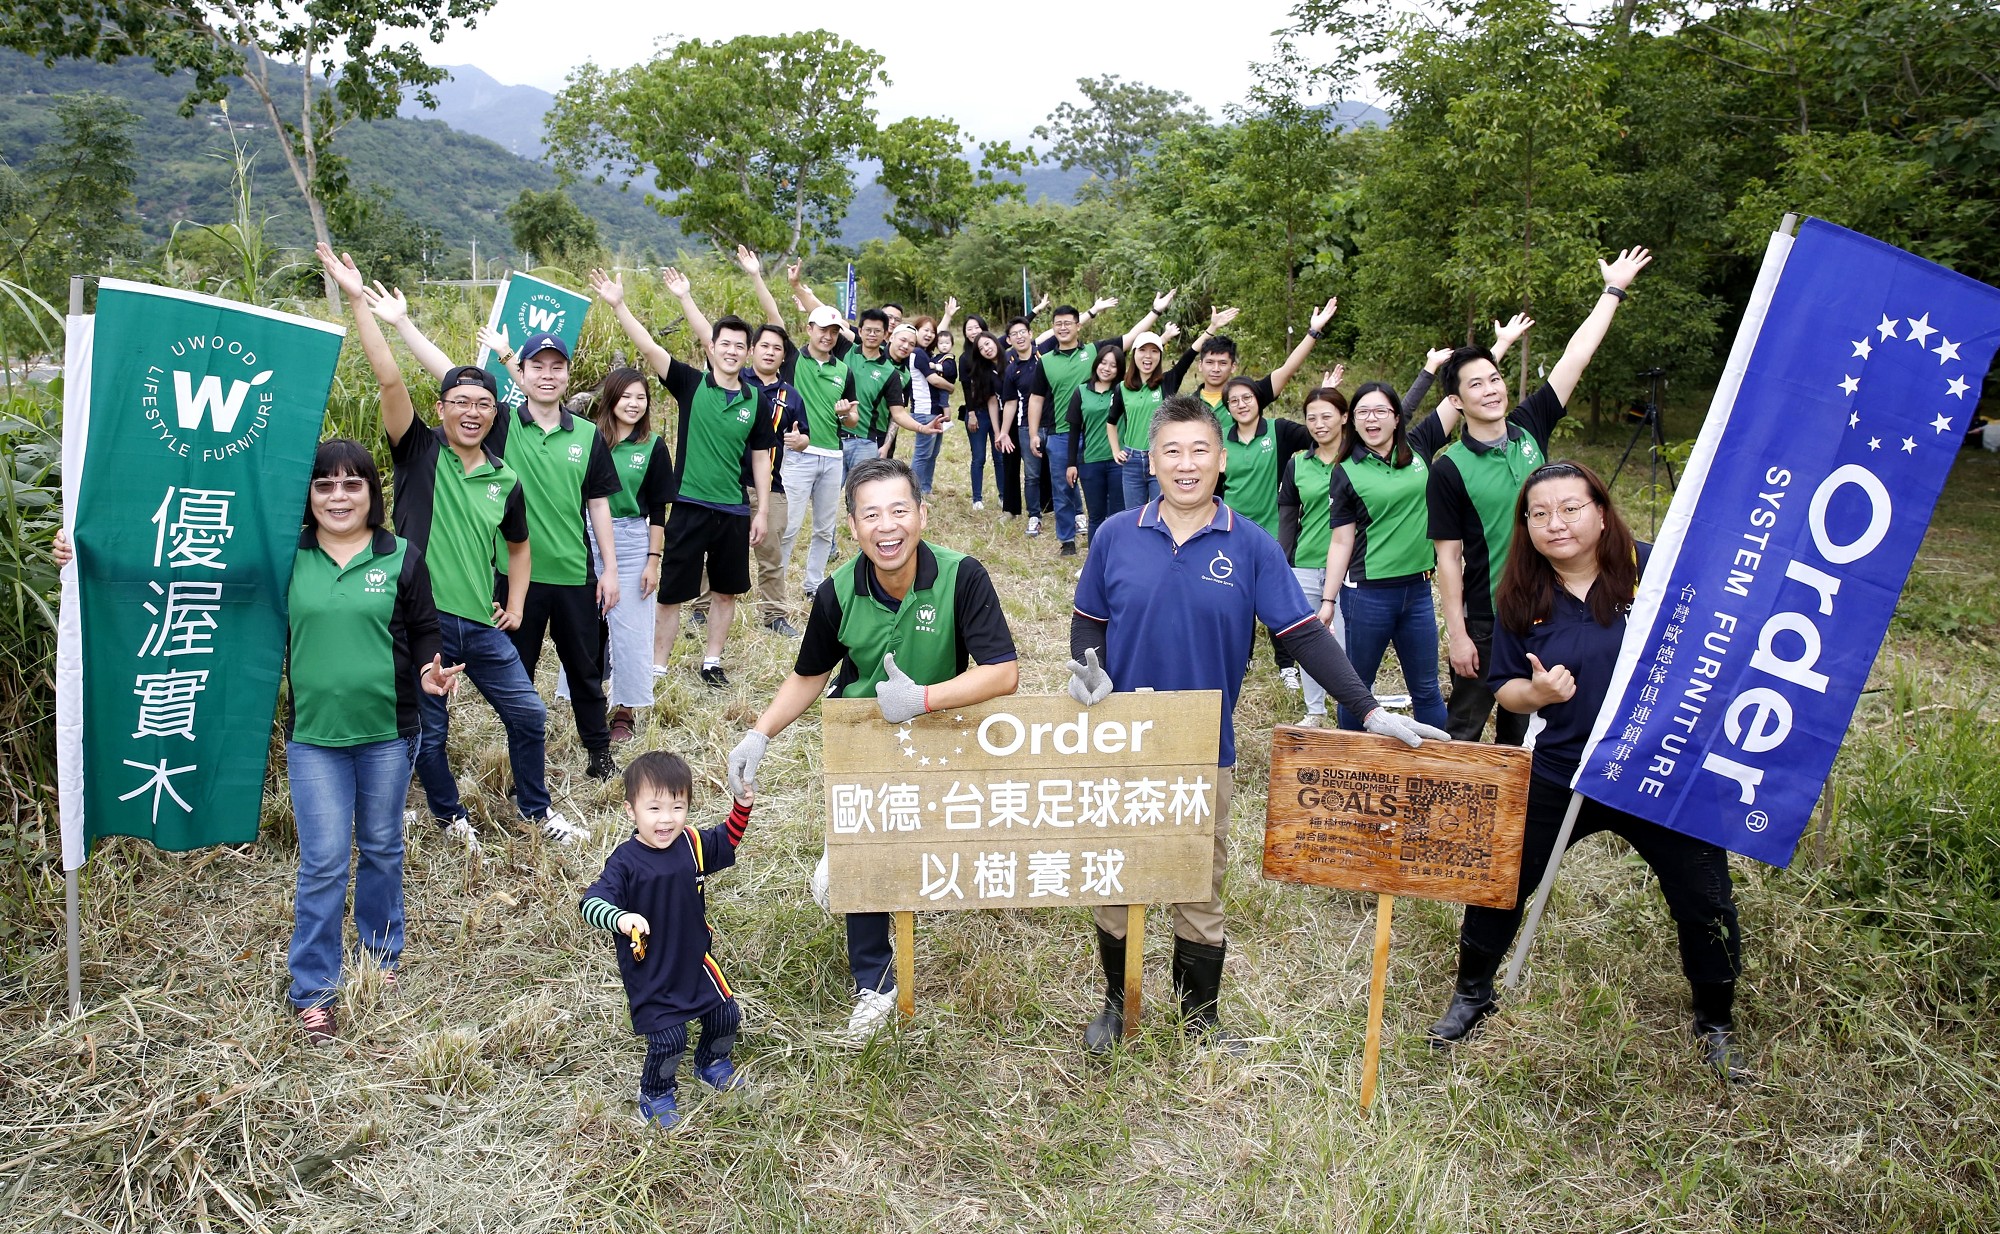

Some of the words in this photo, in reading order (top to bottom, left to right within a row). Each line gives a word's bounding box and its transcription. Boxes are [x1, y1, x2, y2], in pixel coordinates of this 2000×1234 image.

[519, 302, 532, 337] LIFESTYLE
[529, 304, 558, 332] W
[531, 295, 561, 309] UWOOD
[171, 335, 256, 365] UWOOD
[143, 366, 190, 457] LIFESTYLE
[203, 392, 272, 462] FURNITURE
[173, 370, 252, 432] W
[1724, 466, 1792, 597] SYSTEM
[118, 485, 236, 825] 優渥實木
[1600, 583, 1697, 781] 台灣歐德傢俱連鎖事業
[1637, 611, 1738, 798] FURNITURE
[977, 712, 1153, 756] Order
[1322, 779, 1399, 794] DEVELOPMENT
[1323, 768, 1400, 784] SUSTAINABLE
[1297, 786, 1398, 817] GOALS
[919, 849, 1125, 901] 以樹養球
[1308, 854, 1336, 866] Since
